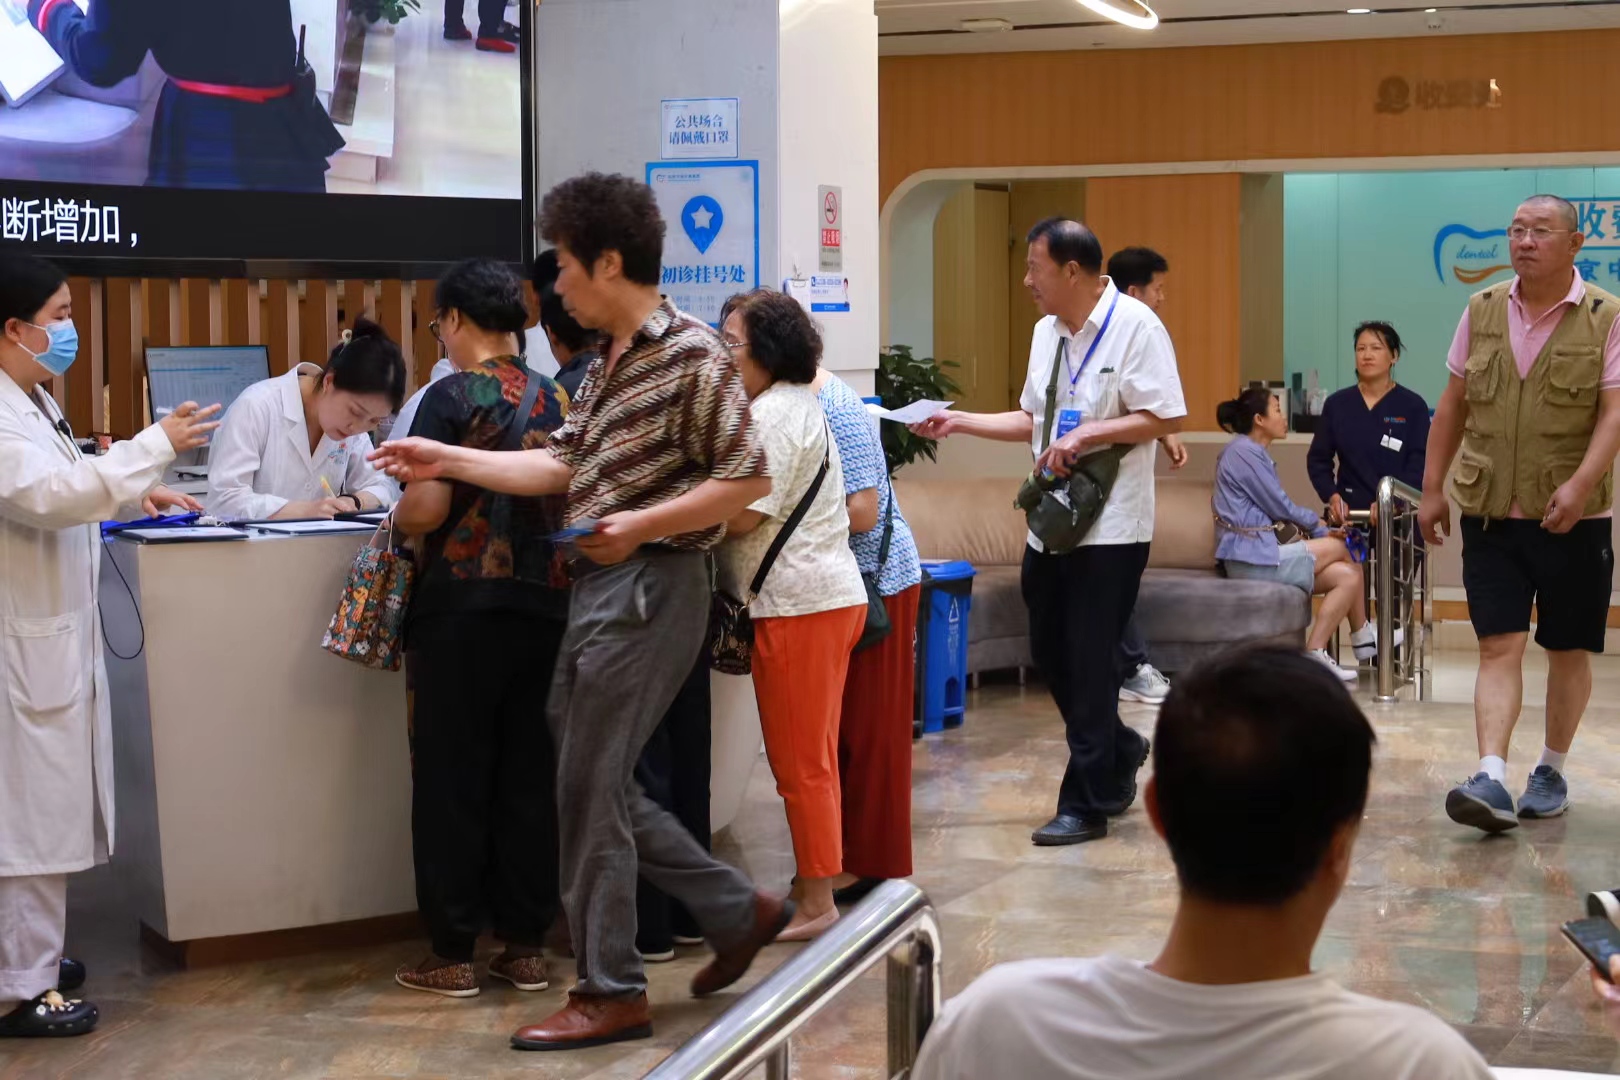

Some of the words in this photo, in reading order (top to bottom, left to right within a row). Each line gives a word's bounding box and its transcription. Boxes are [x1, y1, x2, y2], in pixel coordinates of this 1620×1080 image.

[674, 114, 723, 128] 公共场合
[669, 130, 729, 145] 请佩戴口罩
[661, 264, 746, 284] 初诊挂号处
